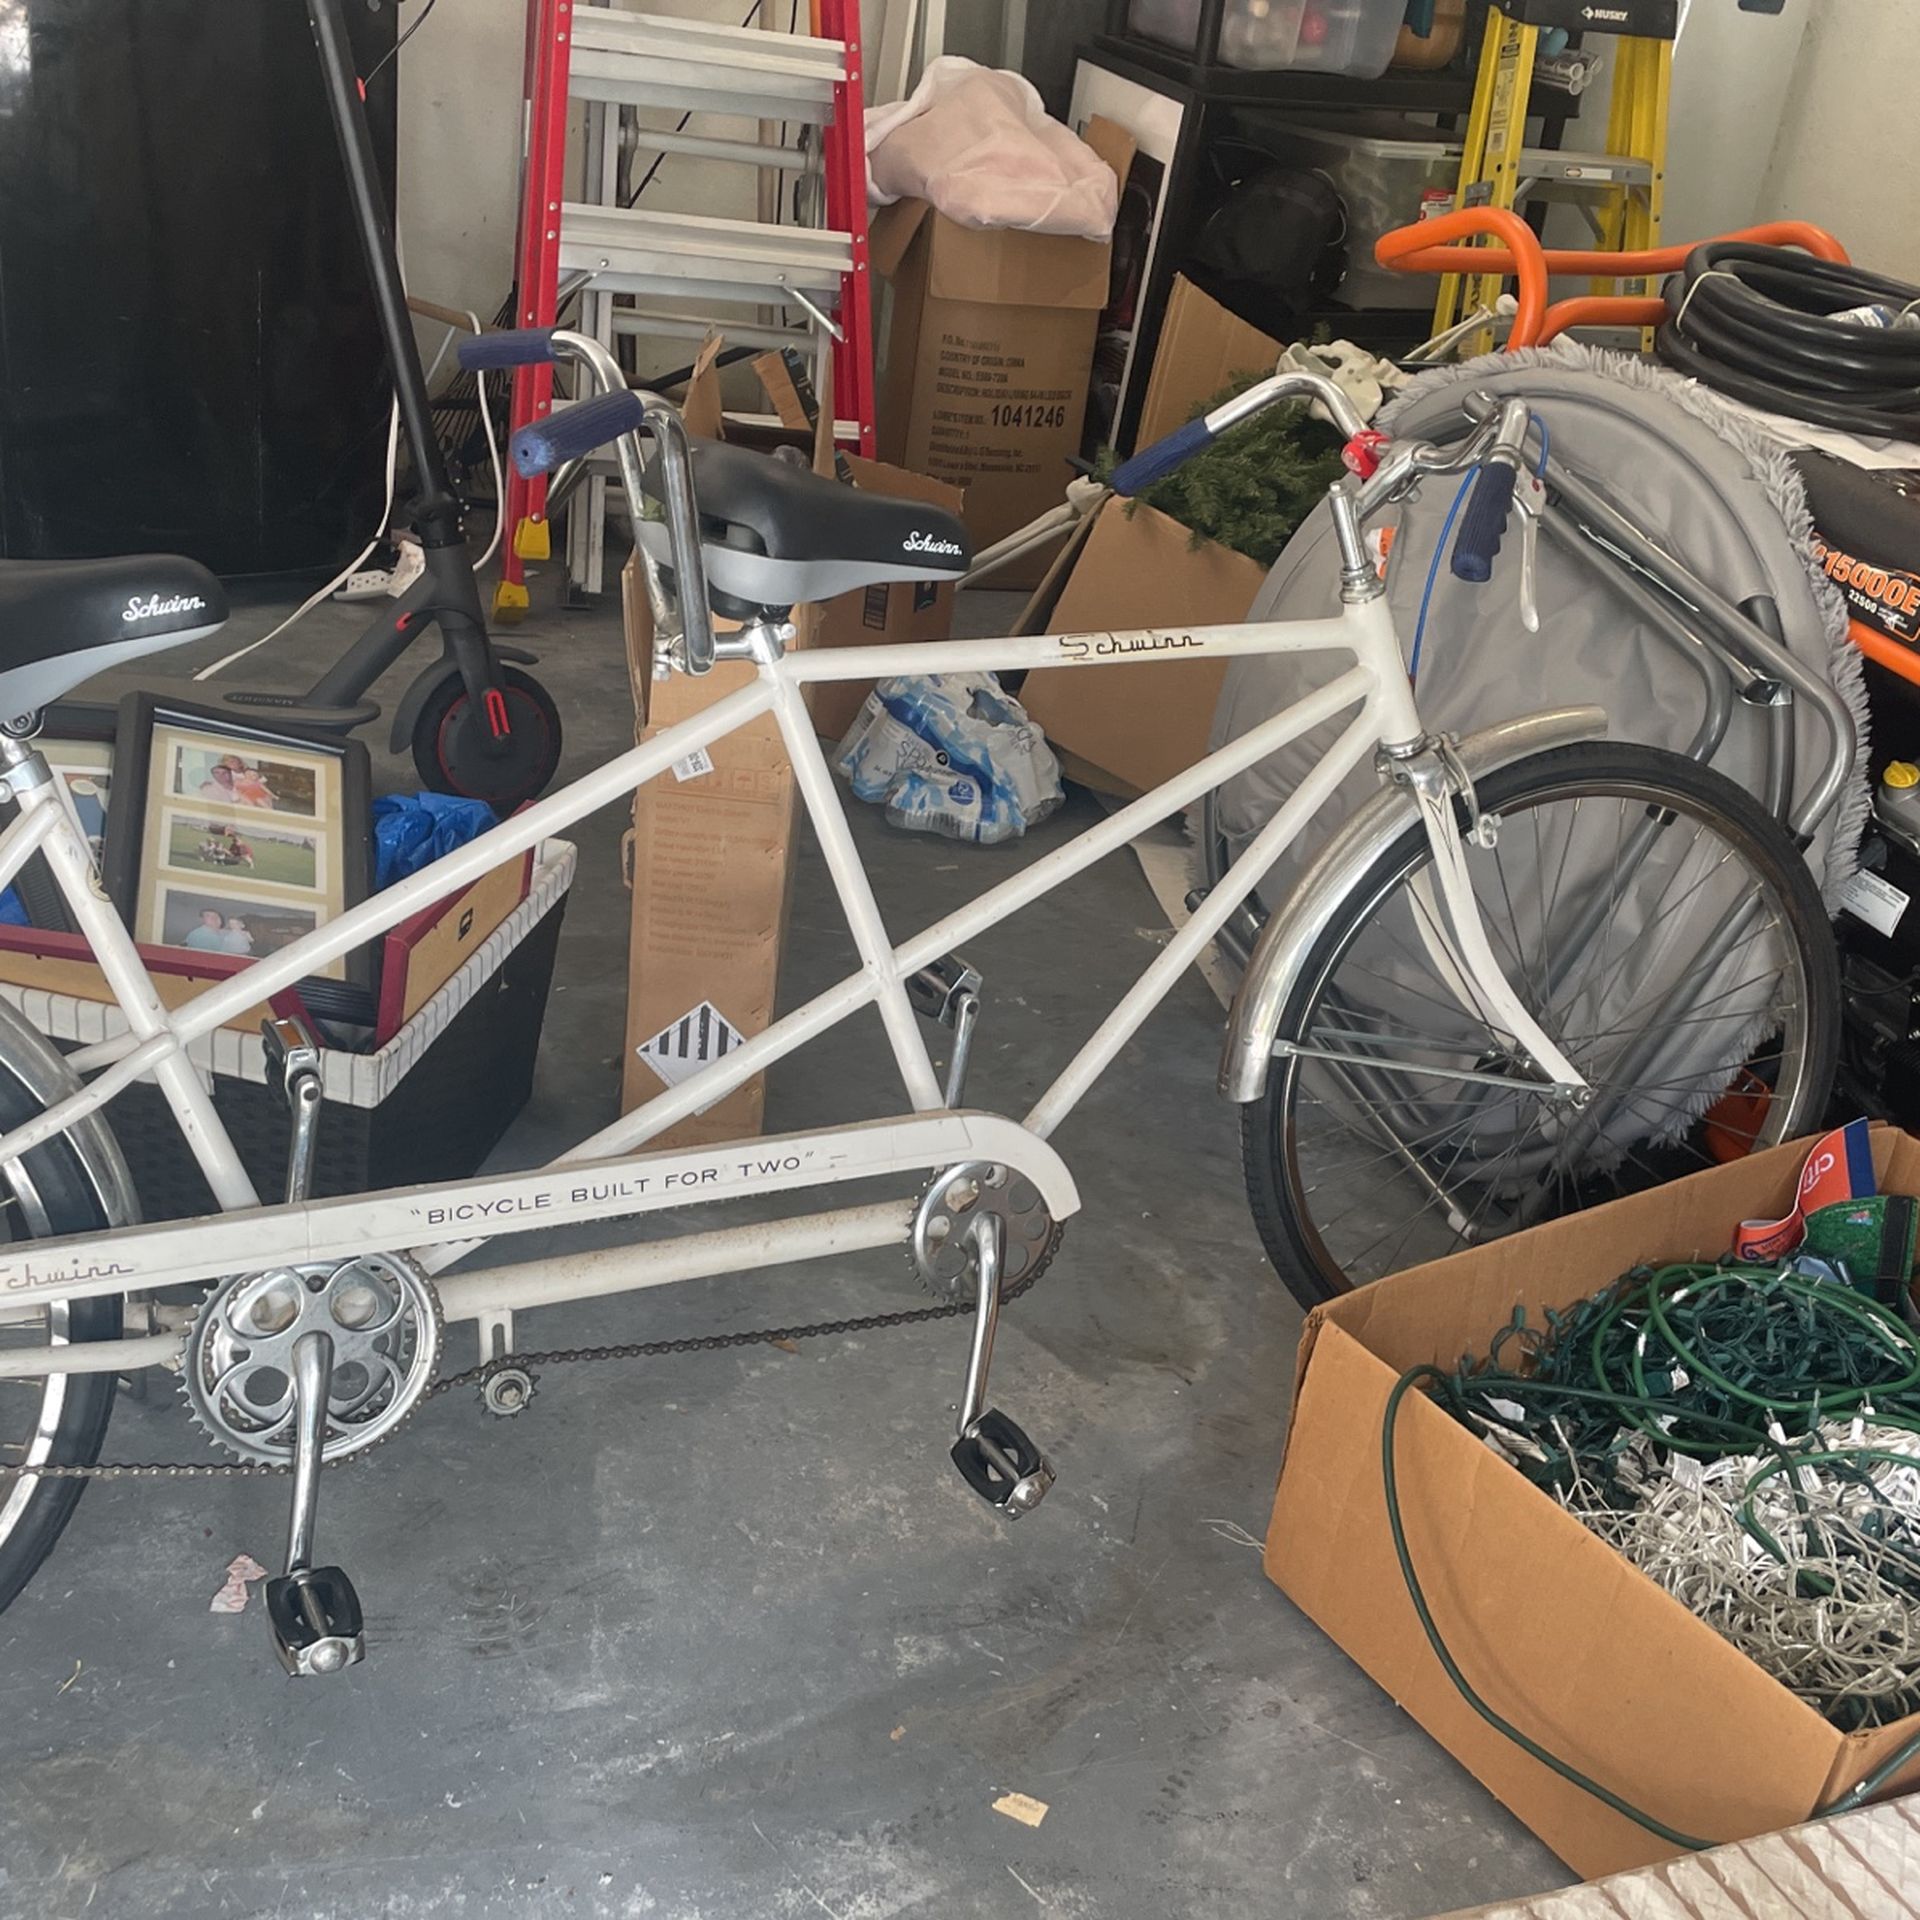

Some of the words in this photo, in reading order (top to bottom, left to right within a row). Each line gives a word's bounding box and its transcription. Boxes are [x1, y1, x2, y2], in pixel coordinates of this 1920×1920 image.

[1594, 8, 1629, 22] HUSKY
[991, 404, 1065, 428] 1041246
[902, 530, 962, 556] Schwinn
[122, 593, 206, 622] Schwinn
[1848, 589, 1878, 614] 22500
[1059, 631, 1204, 660] Schwinn
[570, 1178, 650, 1203] BUILT
[664, 1168, 719, 1189] FOR
